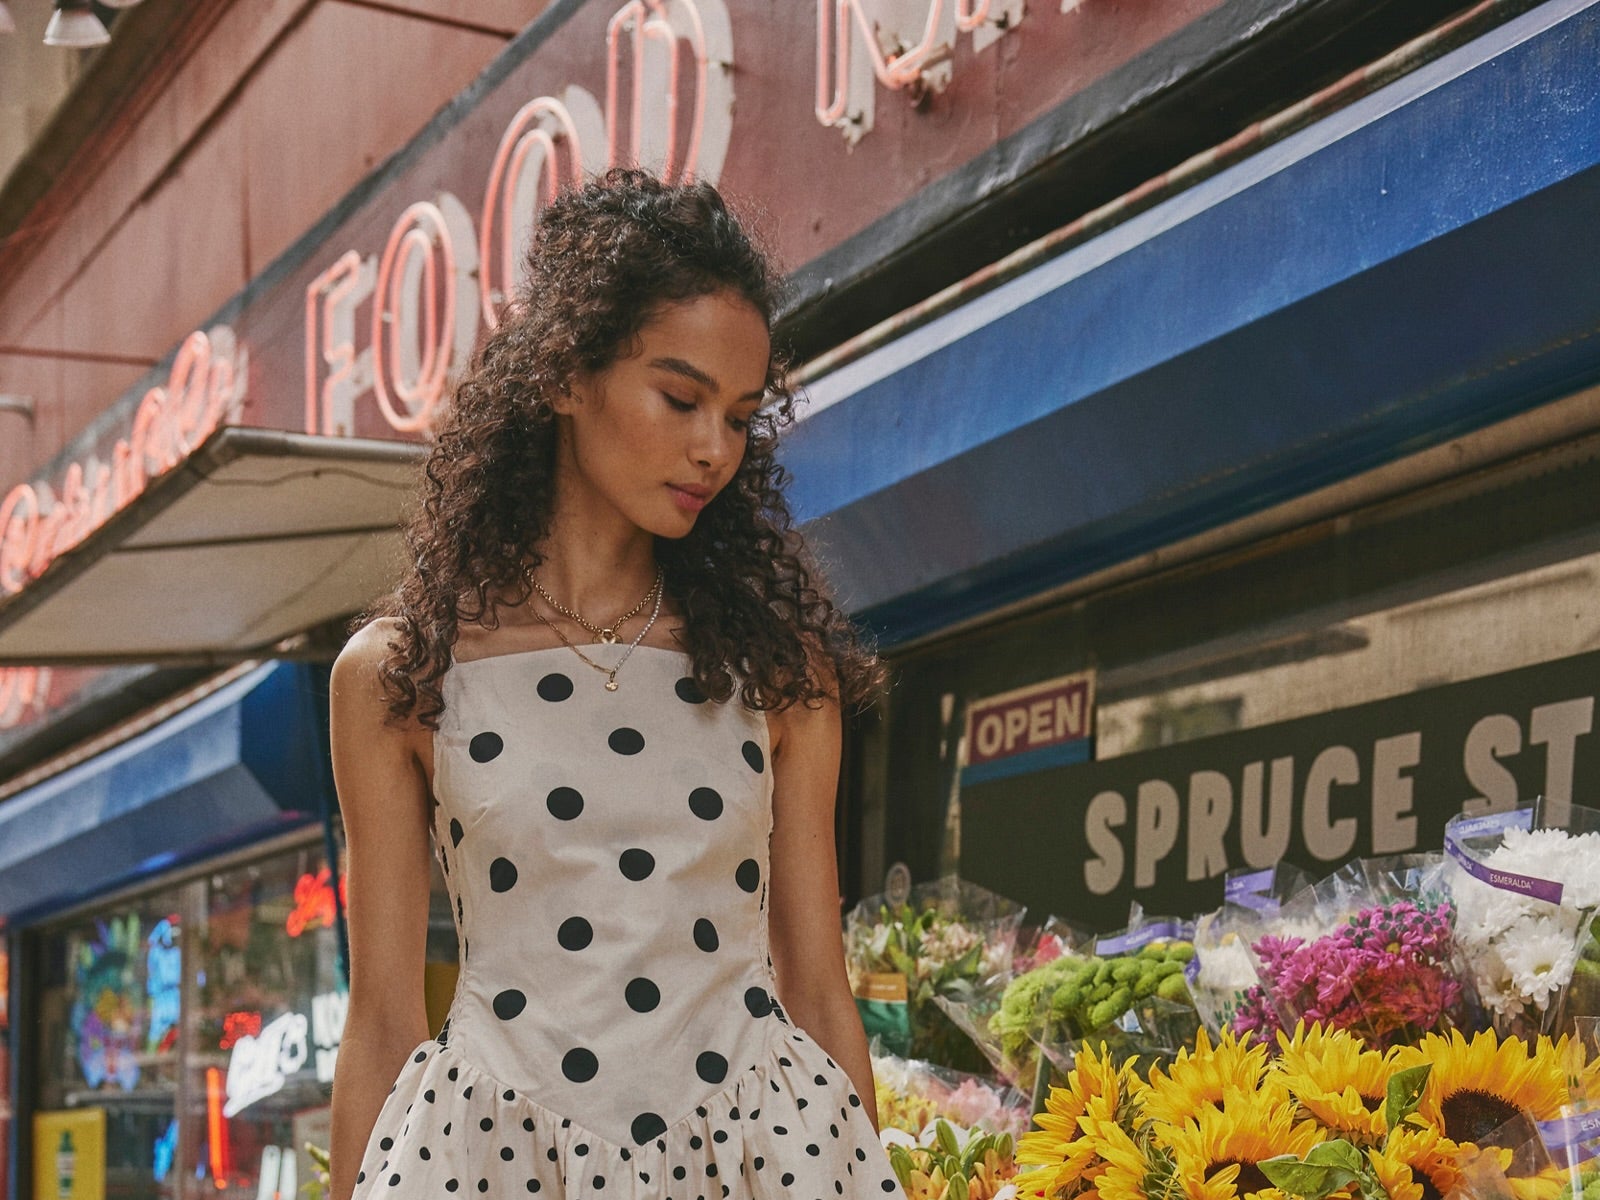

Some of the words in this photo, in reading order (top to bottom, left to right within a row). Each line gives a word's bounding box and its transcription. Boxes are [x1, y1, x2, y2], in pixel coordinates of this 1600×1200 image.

[976, 691, 1081, 757] OPEN
[1084, 731, 1422, 895] SPRUCE
[1462, 697, 1595, 828] ST
